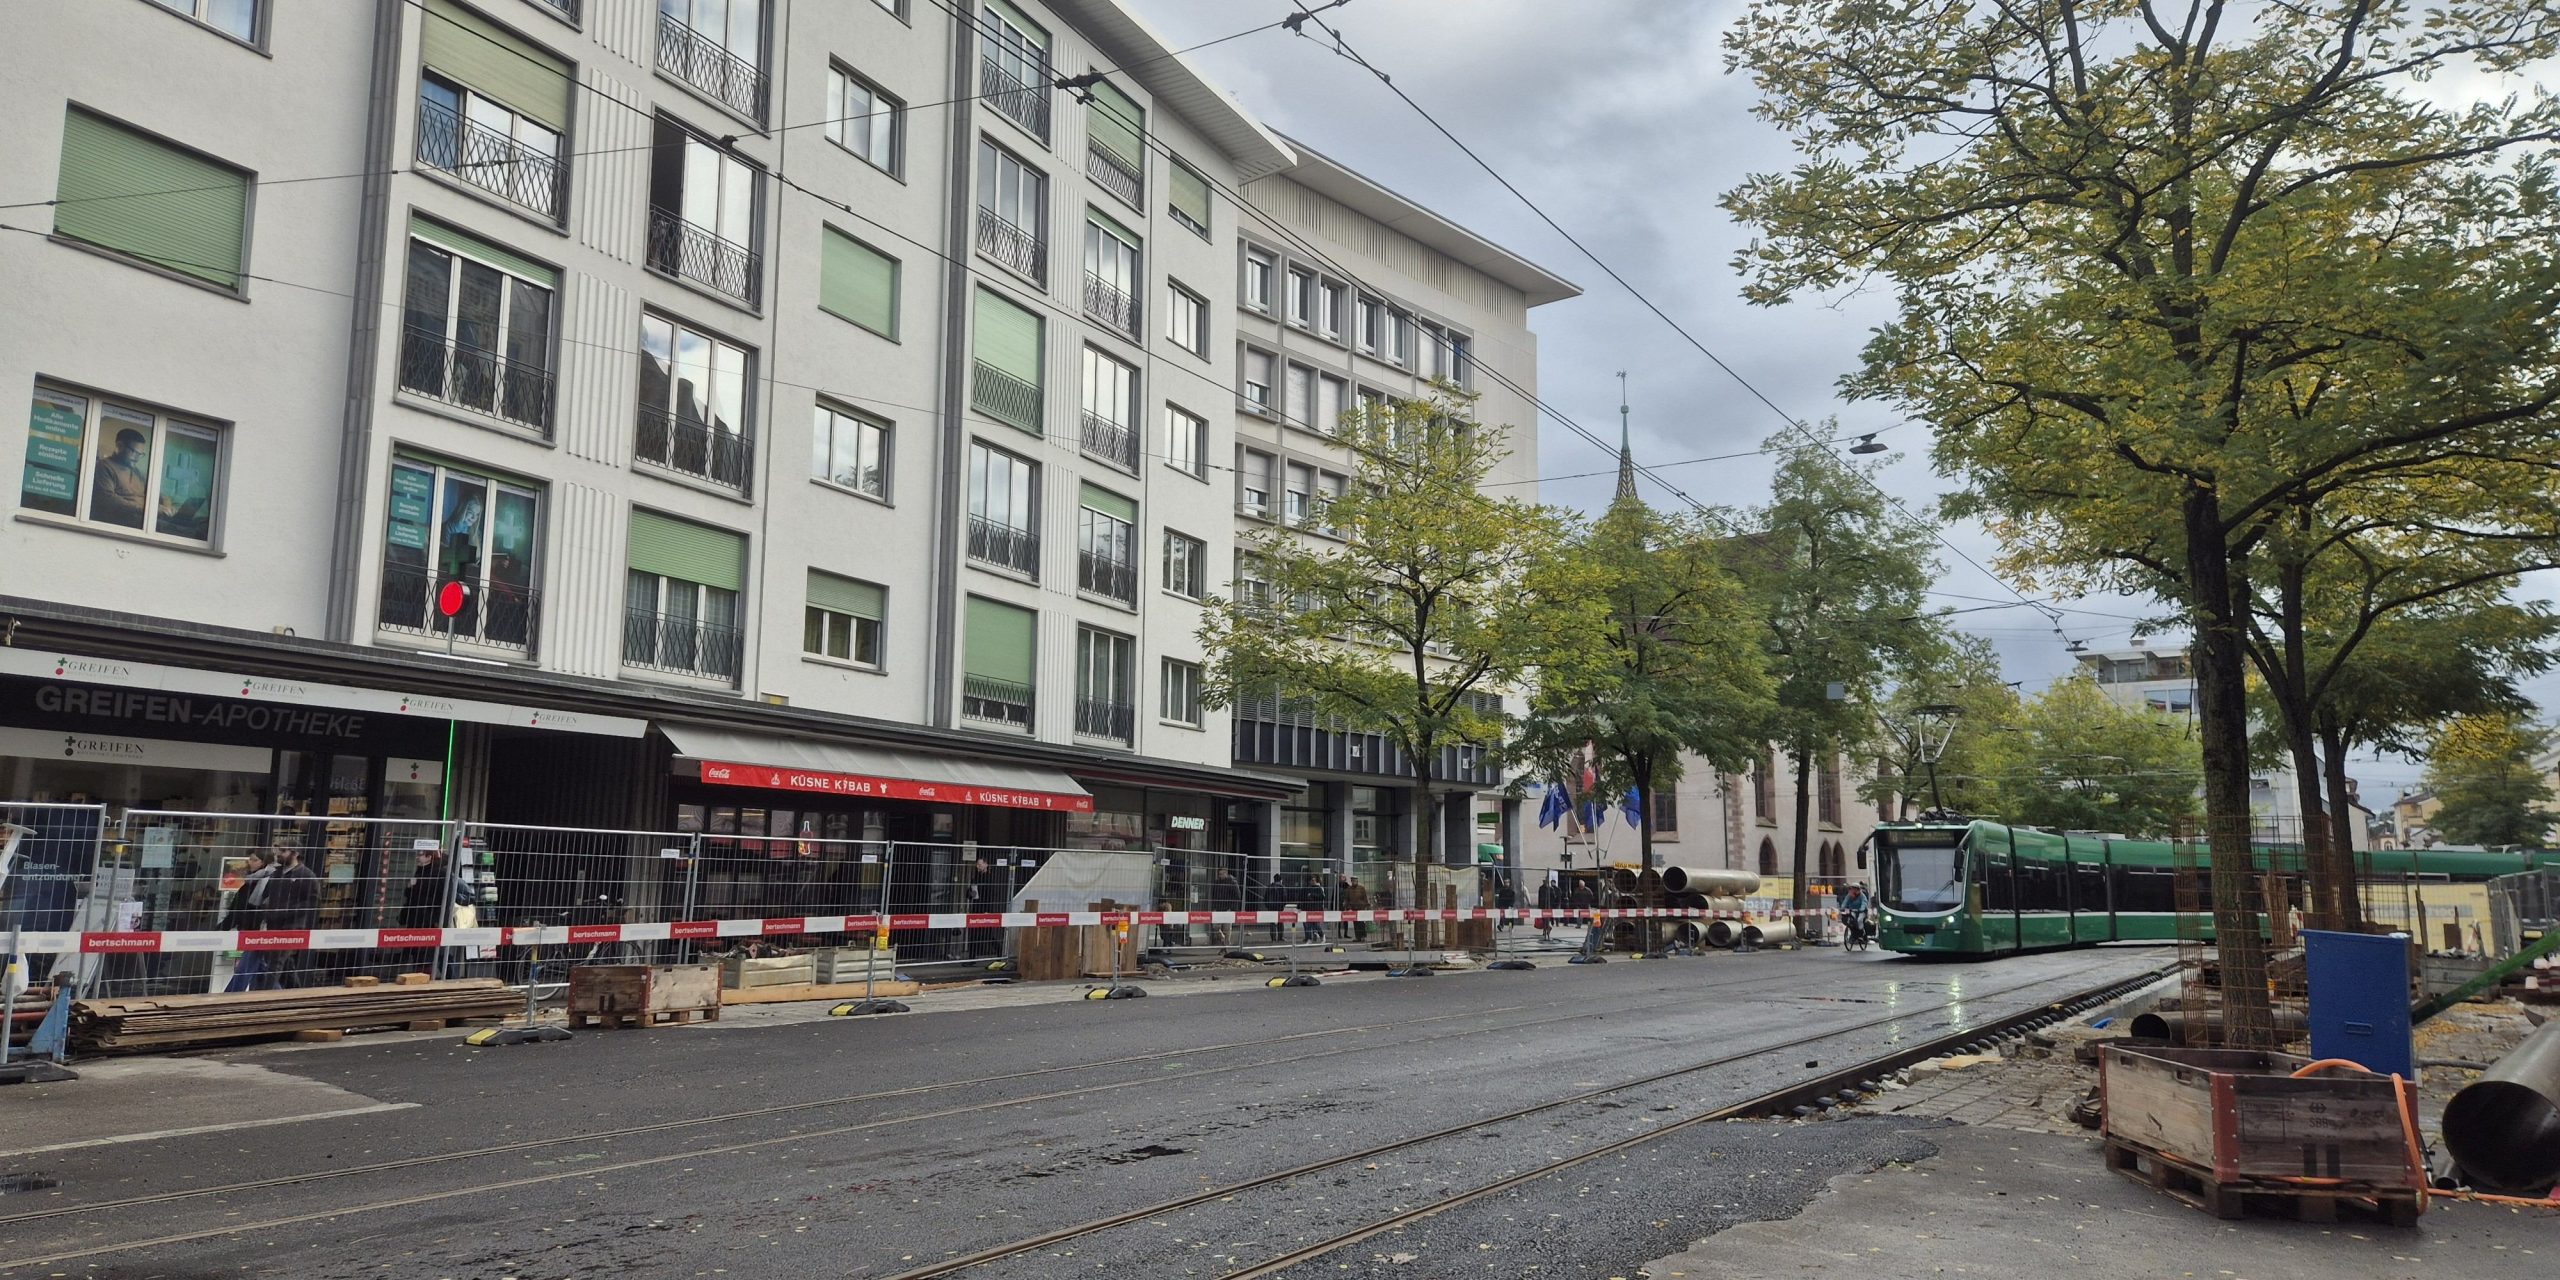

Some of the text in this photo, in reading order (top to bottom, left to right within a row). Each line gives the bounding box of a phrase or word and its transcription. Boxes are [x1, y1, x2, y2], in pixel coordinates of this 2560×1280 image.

[68, 660, 129, 676] GREIFEN
[252, 681, 307, 696] GREIFEN
[409, 699, 454, 712] GREIFEN
[36, 685, 364, 738] GREIFEN-APOTHEKE
[539, 713, 577, 725] GREIFEN
[78, 739, 145, 754] GREIFEN
[1171, 815, 1205, 830] DENNER
[23, 861, 60, 871] Blasen-
[674, 926, 714, 934] bertschmann
[765, 922, 801, 931] bertschmann
[383, 934, 436, 943] bertschmann
[573, 930, 617, 939] bertschmann
[89, 937, 155, 947] bertschmann
[245, 936, 304, 945] bertschmann
